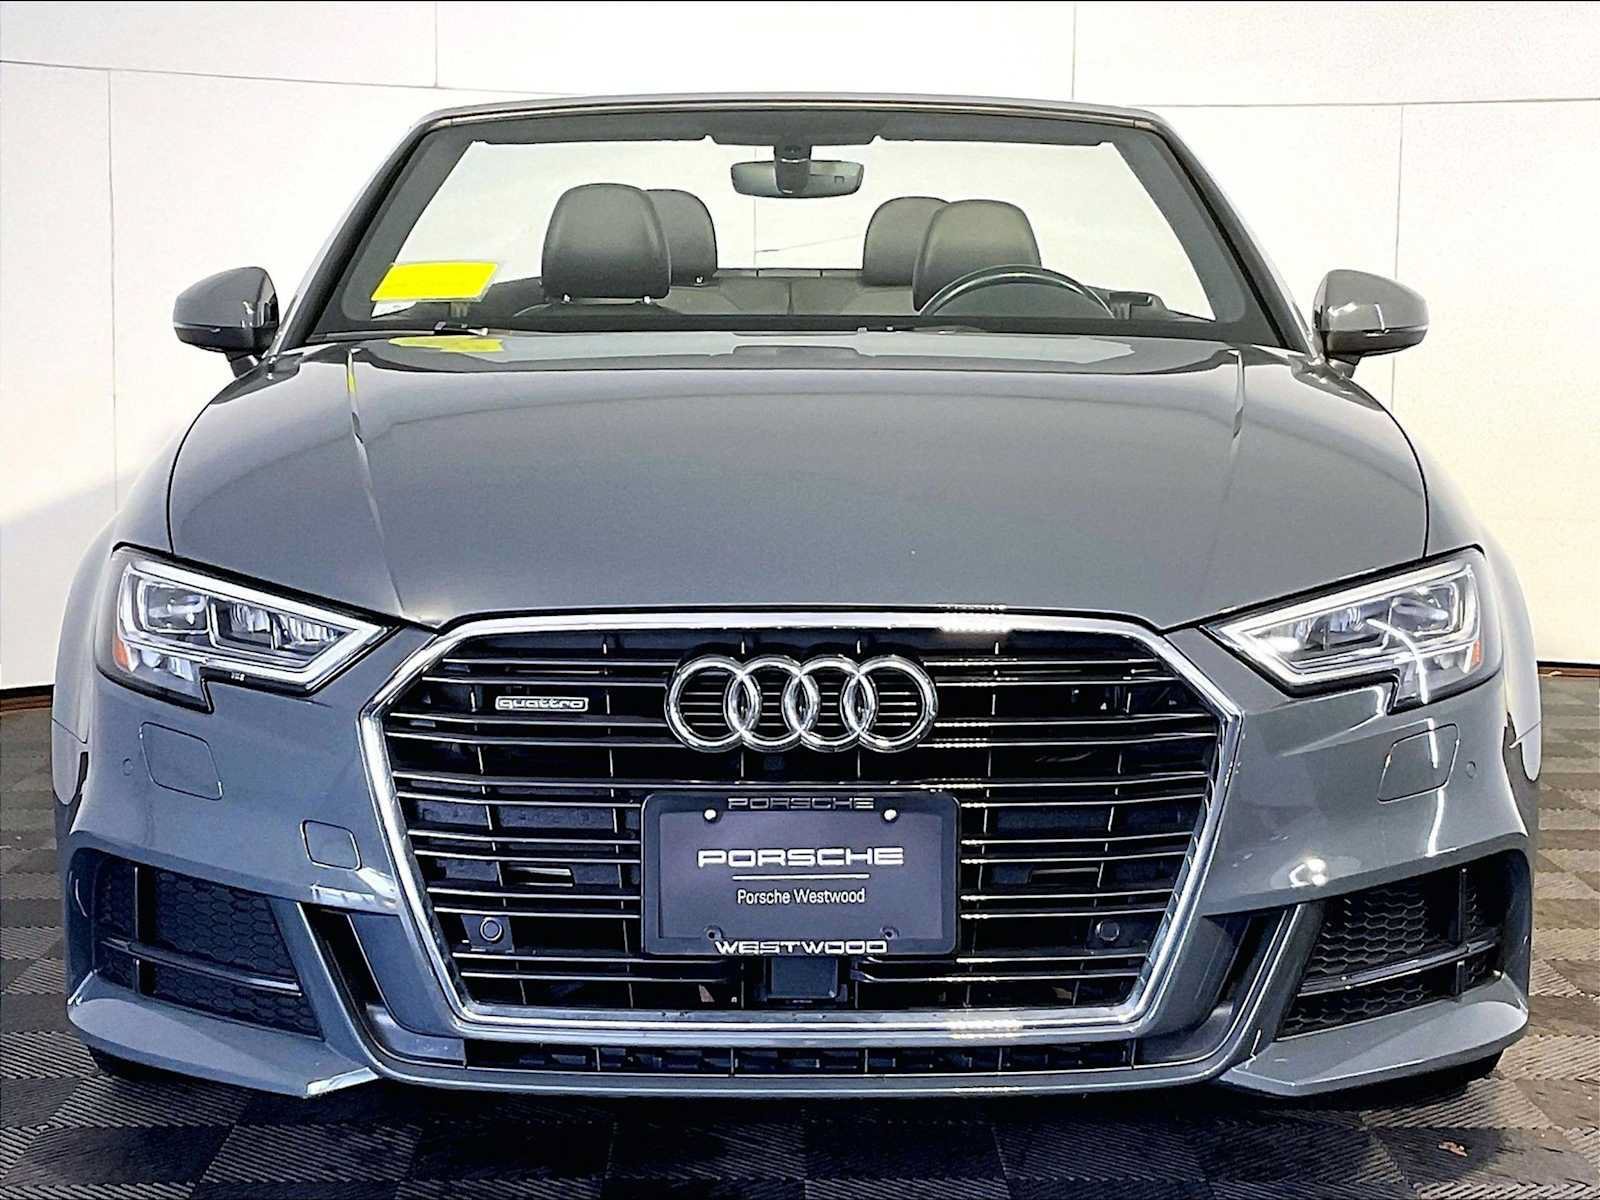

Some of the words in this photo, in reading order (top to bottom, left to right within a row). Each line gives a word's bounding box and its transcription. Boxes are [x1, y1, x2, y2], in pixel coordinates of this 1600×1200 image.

[498, 698, 585, 710] quattro
[728, 797, 874, 809] PORSCHE
[697, 847, 904, 867] PORSCHE
[737, 889, 790, 904] Porsche
[794, 888, 865, 904] Westwood
[715, 940, 887, 954] WESTWOOD
